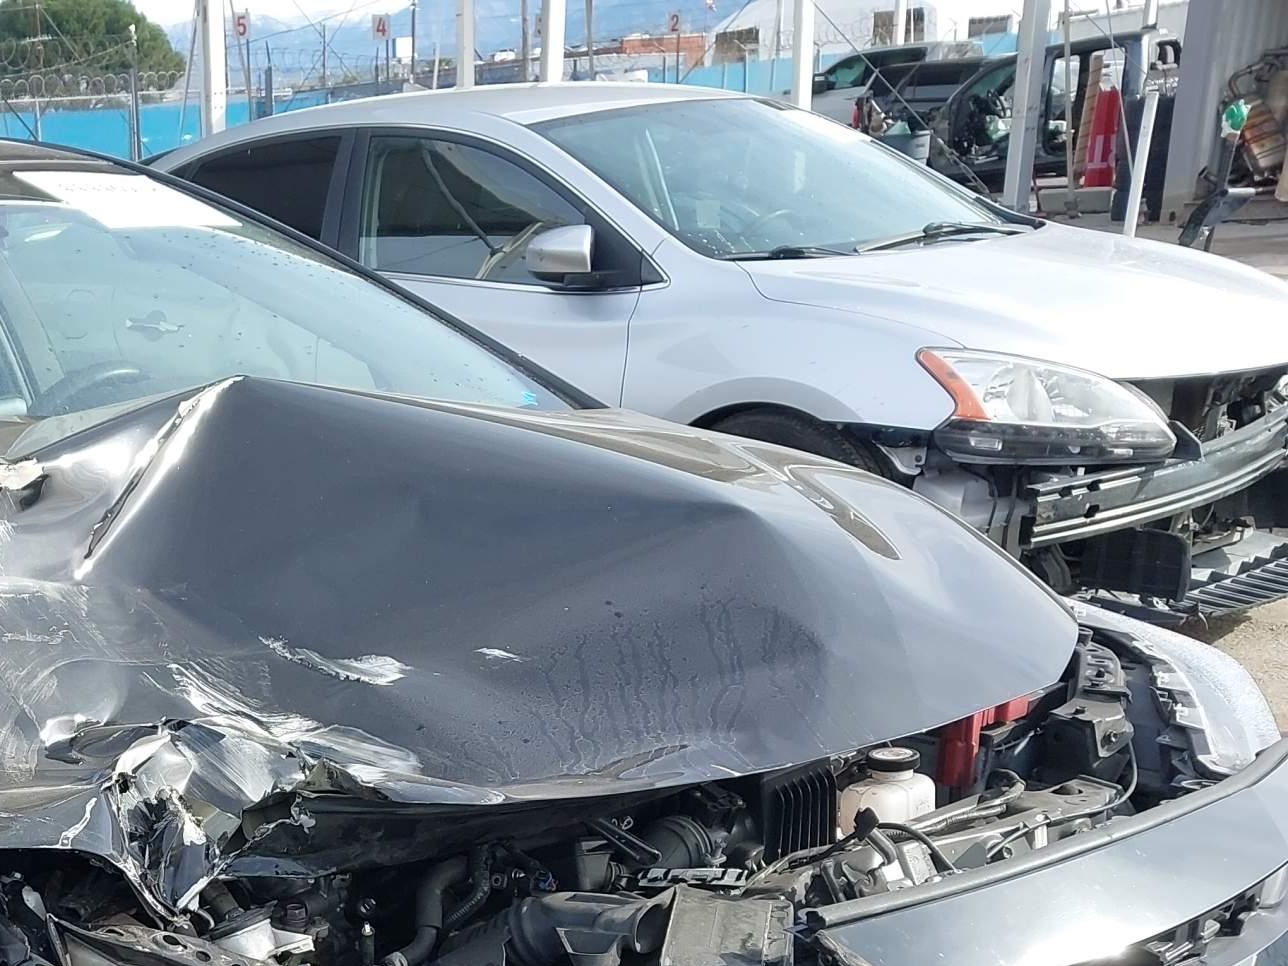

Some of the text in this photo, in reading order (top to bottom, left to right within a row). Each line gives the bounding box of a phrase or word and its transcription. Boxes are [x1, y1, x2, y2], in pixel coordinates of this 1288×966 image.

[237, 15, 247, 36] 5
[376, 17, 387, 36] 4
[671, 14, 679, 31] 2
